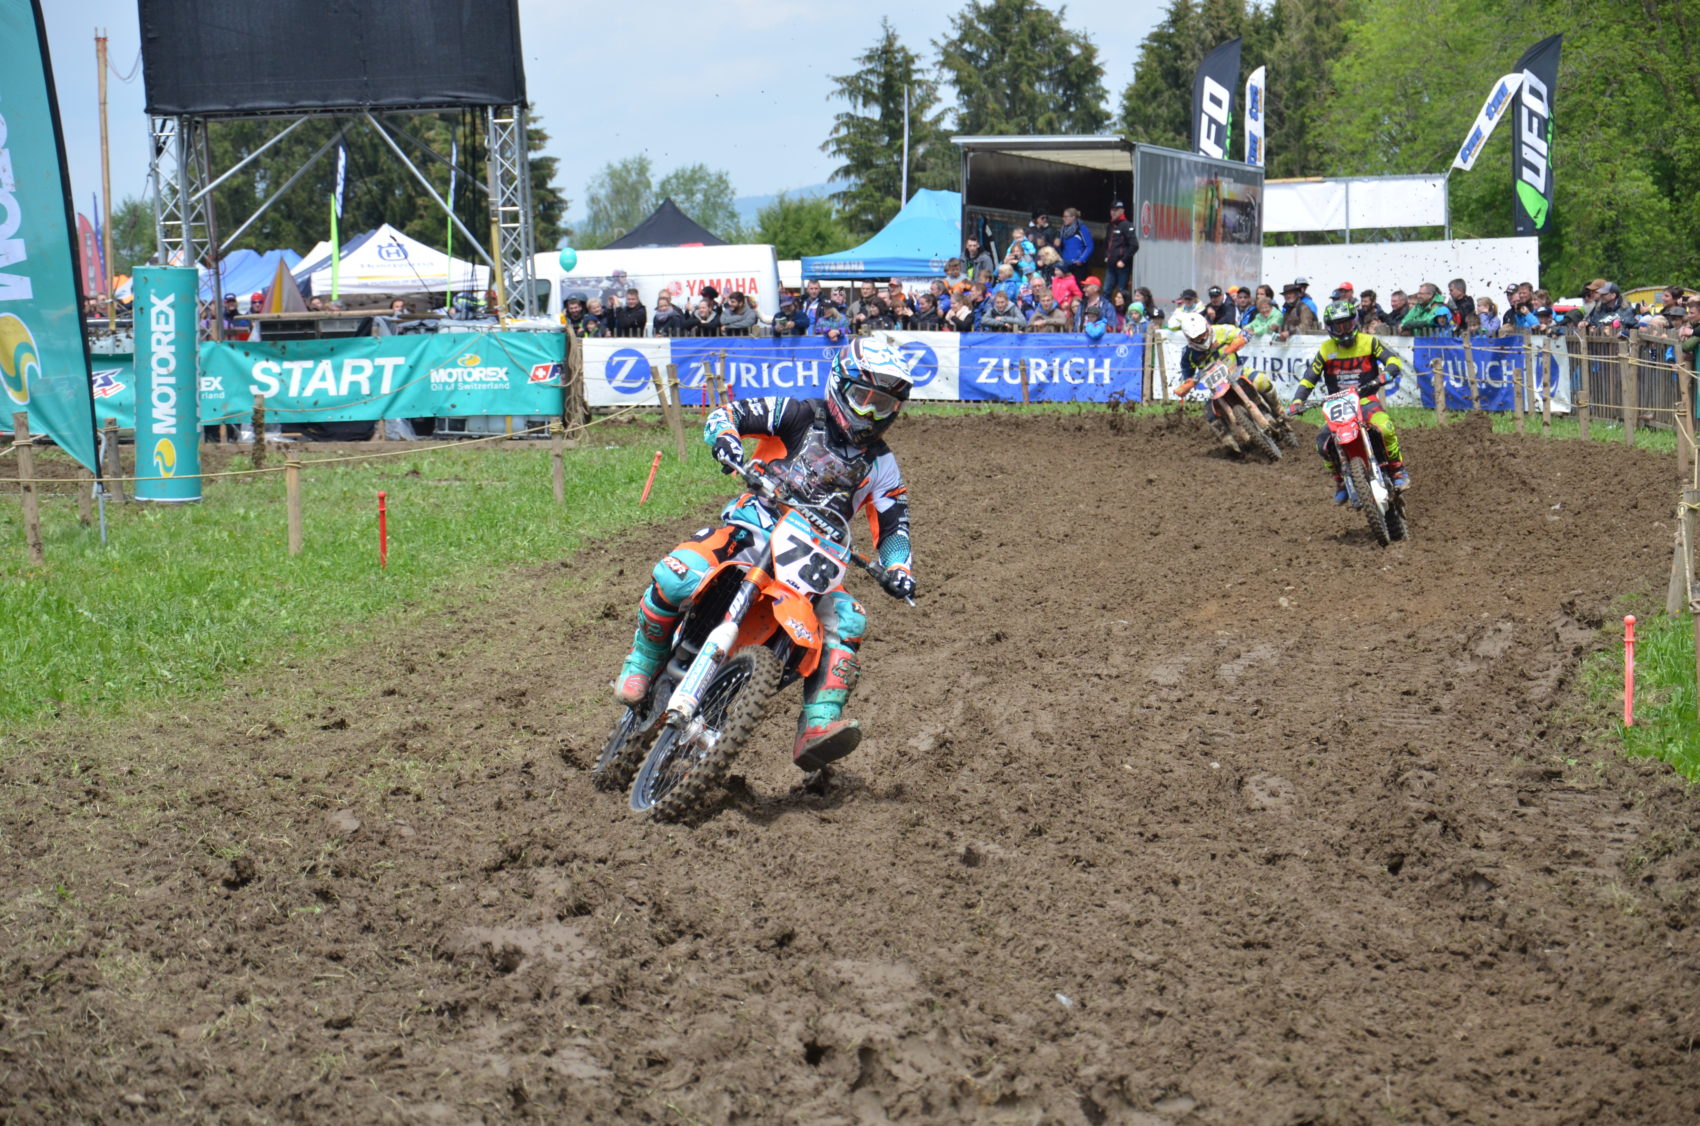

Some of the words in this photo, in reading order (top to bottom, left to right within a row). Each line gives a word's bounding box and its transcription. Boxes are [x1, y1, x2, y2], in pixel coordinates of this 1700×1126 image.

[1199, 75, 1230, 160] FO
[1521, 68, 1549, 194] UFO
[687, 277, 758, 296] YAMAHA
[150, 293, 176, 434] MOTOREX
[249, 356, 406, 399] START
[430, 367, 509, 383] MOTOREX
[689, 360, 819, 389] ZURICH
[975, 356, 1112, 385] ZURICH
[1237, 356, 1310, 382] ZURIC
[457, 382, 510, 391] Switzerland
[776, 534, 840, 593] 78
